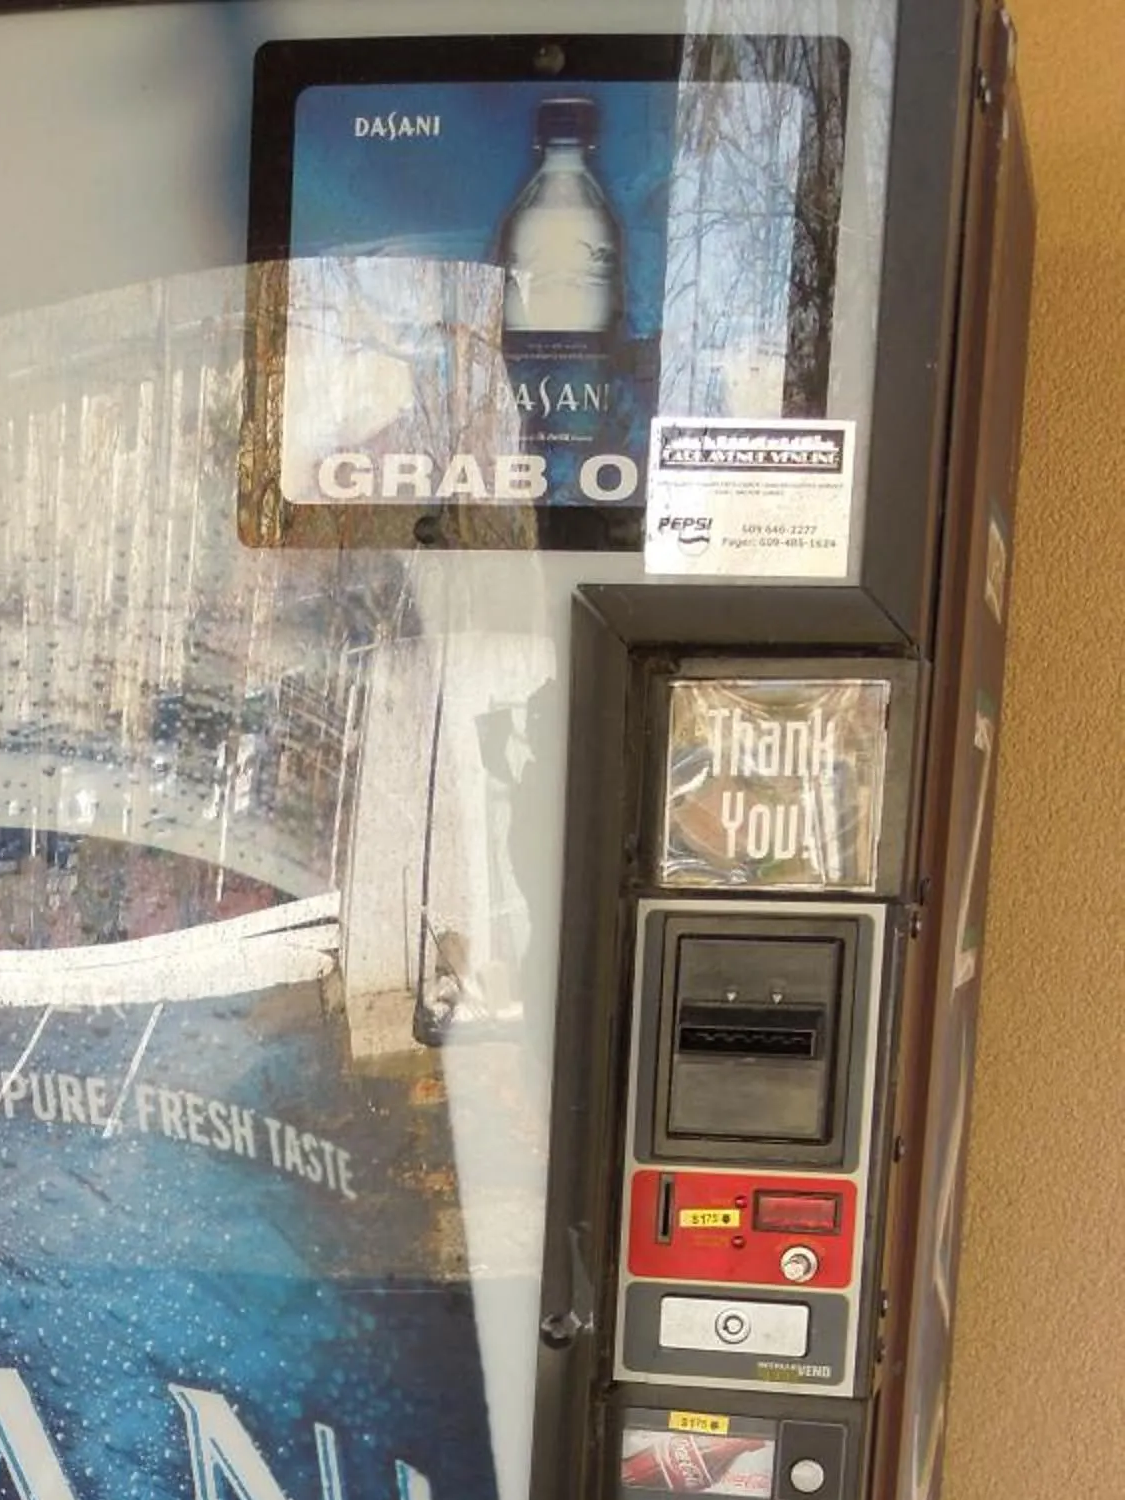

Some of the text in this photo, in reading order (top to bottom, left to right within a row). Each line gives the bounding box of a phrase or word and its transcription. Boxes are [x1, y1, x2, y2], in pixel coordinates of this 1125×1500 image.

[354, 111, 442, 139] DASANI
[318, 453, 547, 501] GRAB
[658, 516, 713, 531] PEPSI
[708, 707, 837, 778] Thank
[137, 1083, 258, 1159] FRESH
[264, 1117, 358, 1200] TASTE
